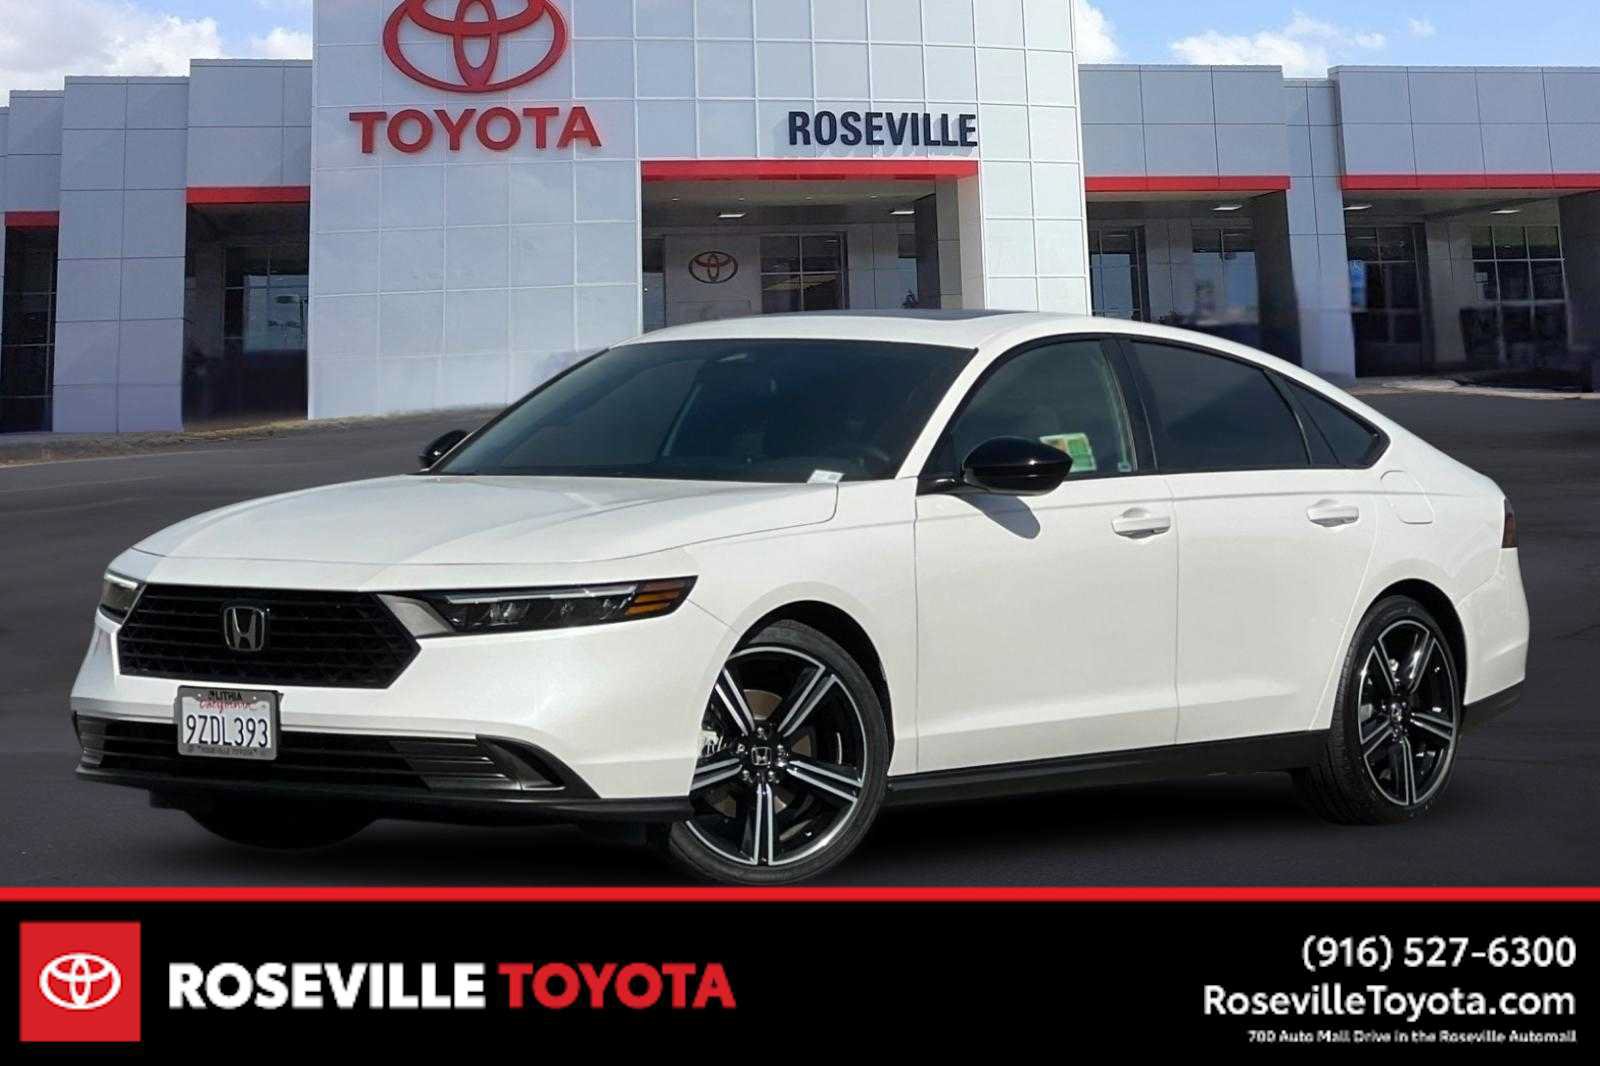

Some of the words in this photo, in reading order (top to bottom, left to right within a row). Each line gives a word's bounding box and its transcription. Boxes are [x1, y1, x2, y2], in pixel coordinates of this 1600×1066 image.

[349, 106, 602, 154] TOYOTA
[788, 111, 978, 147] ROSEVILLE
[186, 714, 268, 748] 9ZDL393
